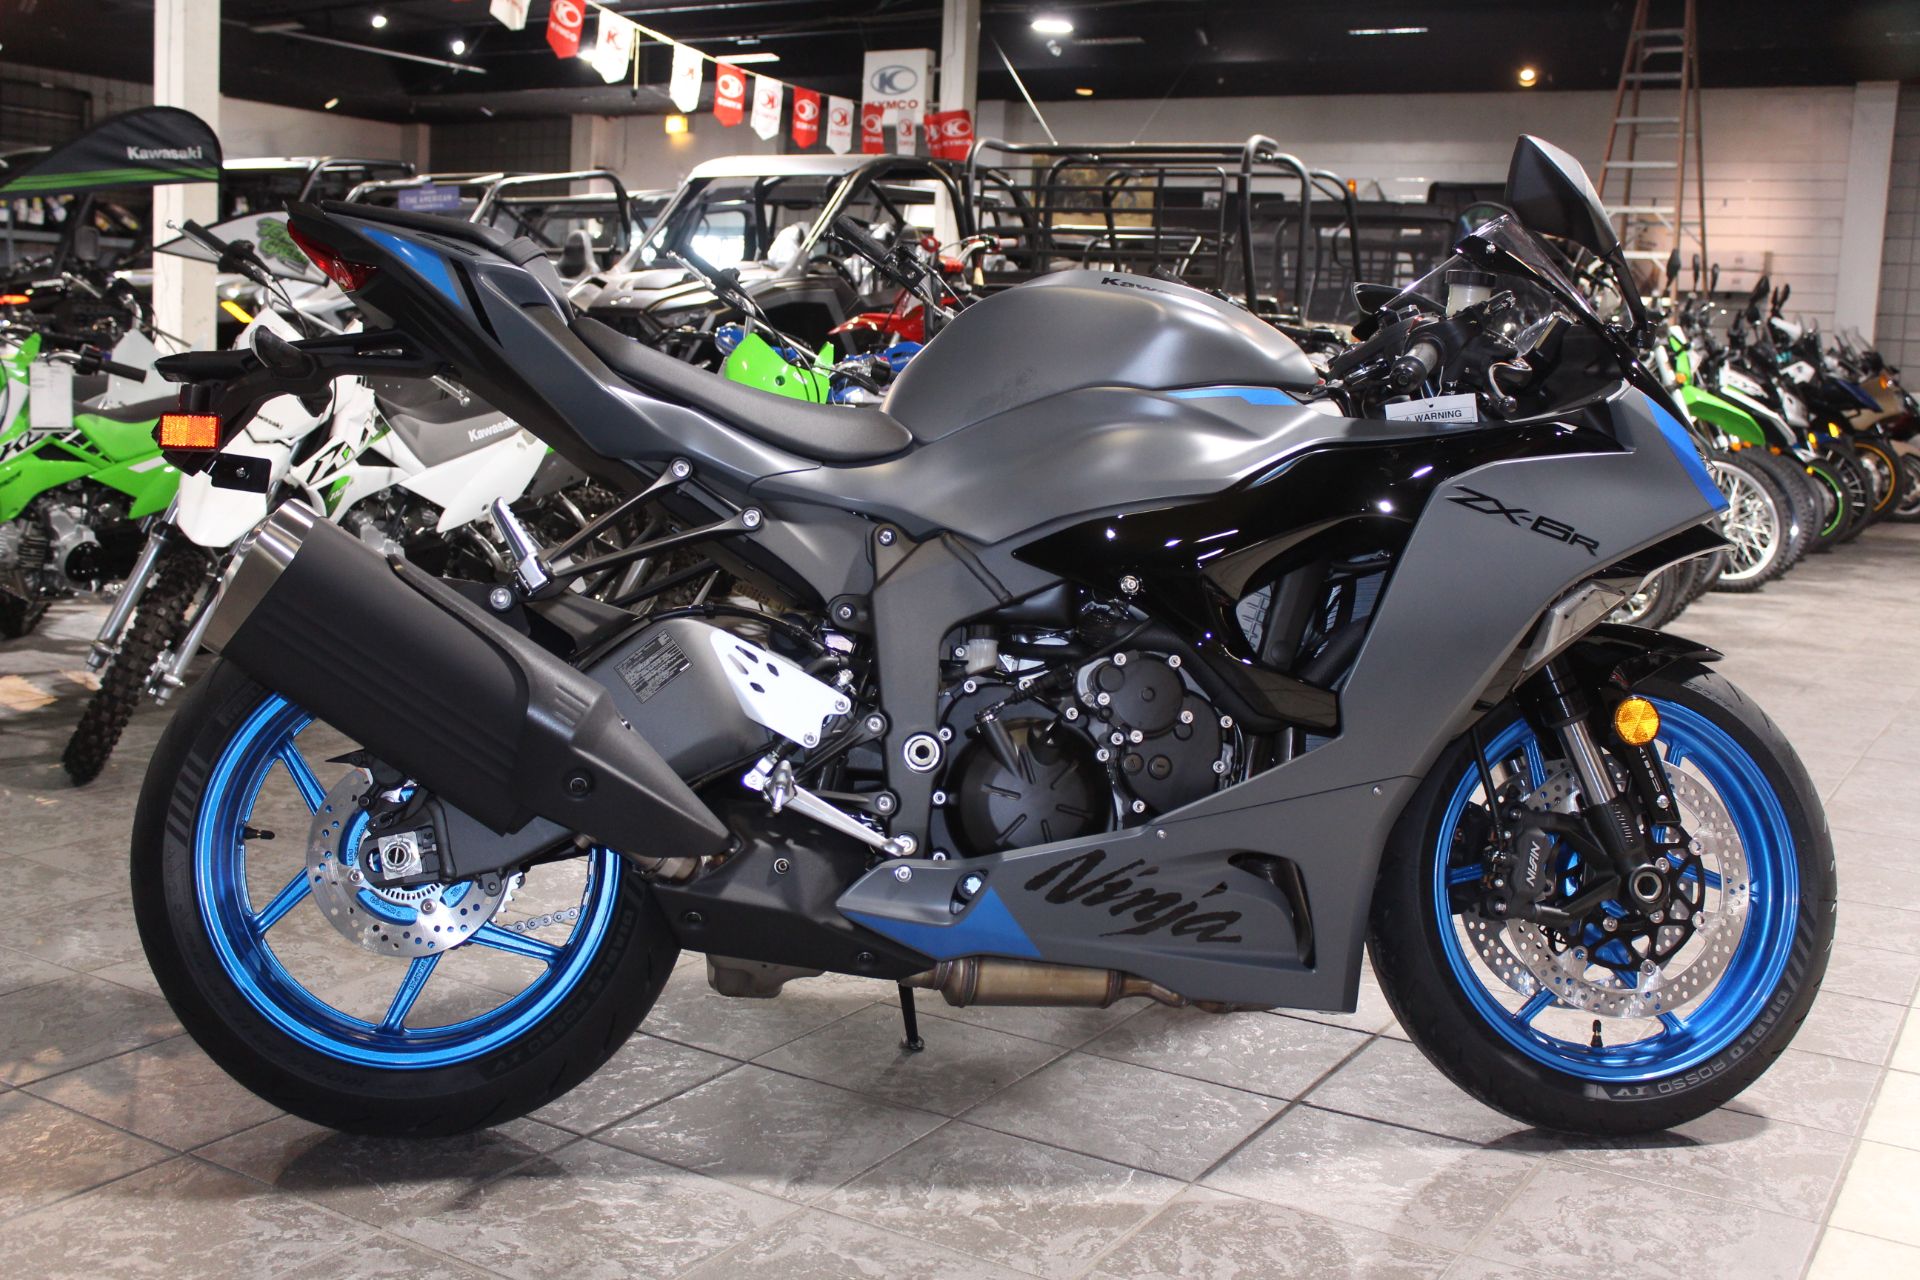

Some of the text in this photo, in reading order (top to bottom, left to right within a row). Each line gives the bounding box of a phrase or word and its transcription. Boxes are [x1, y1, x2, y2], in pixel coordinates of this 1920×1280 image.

[870, 99, 919, 110] YMCO
[126, 146, 203, 160] Kawasaki
[468, 416, 519, 442] Kawasak
[1415, 409, 1462, 422] WARNING
[1447, 486, 1600, 557] ZX-6R
[1526, 841, 1541, 888] NISSIN
[1024, 849, 1242, 943] Ninja
[1729, 991, 1793, 1059] DIABLO
[1657, 1061, 1727, 1095] ROSSO
